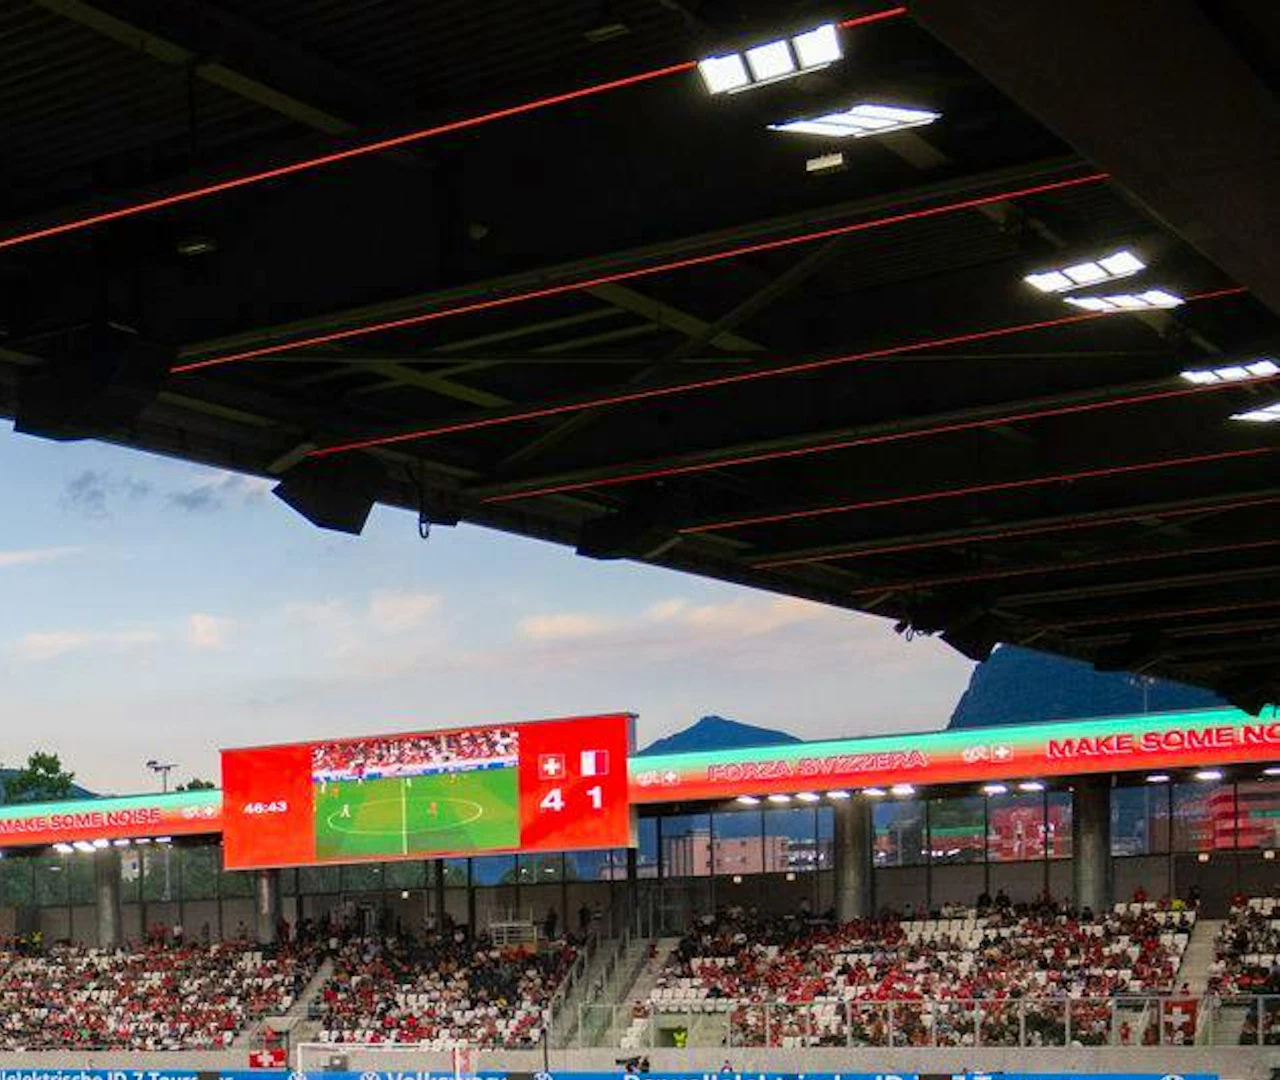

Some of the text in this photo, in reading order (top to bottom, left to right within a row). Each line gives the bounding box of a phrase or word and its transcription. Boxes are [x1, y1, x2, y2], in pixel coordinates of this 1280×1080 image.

[1046, 733, 1134, 758] MAKE
[1140, 726, 1234, 751] SOME
[540, 786, 602, 812] 4 1
[49, 812, 102, 830] SOME
[104, 807, 162, 827] NOISE
